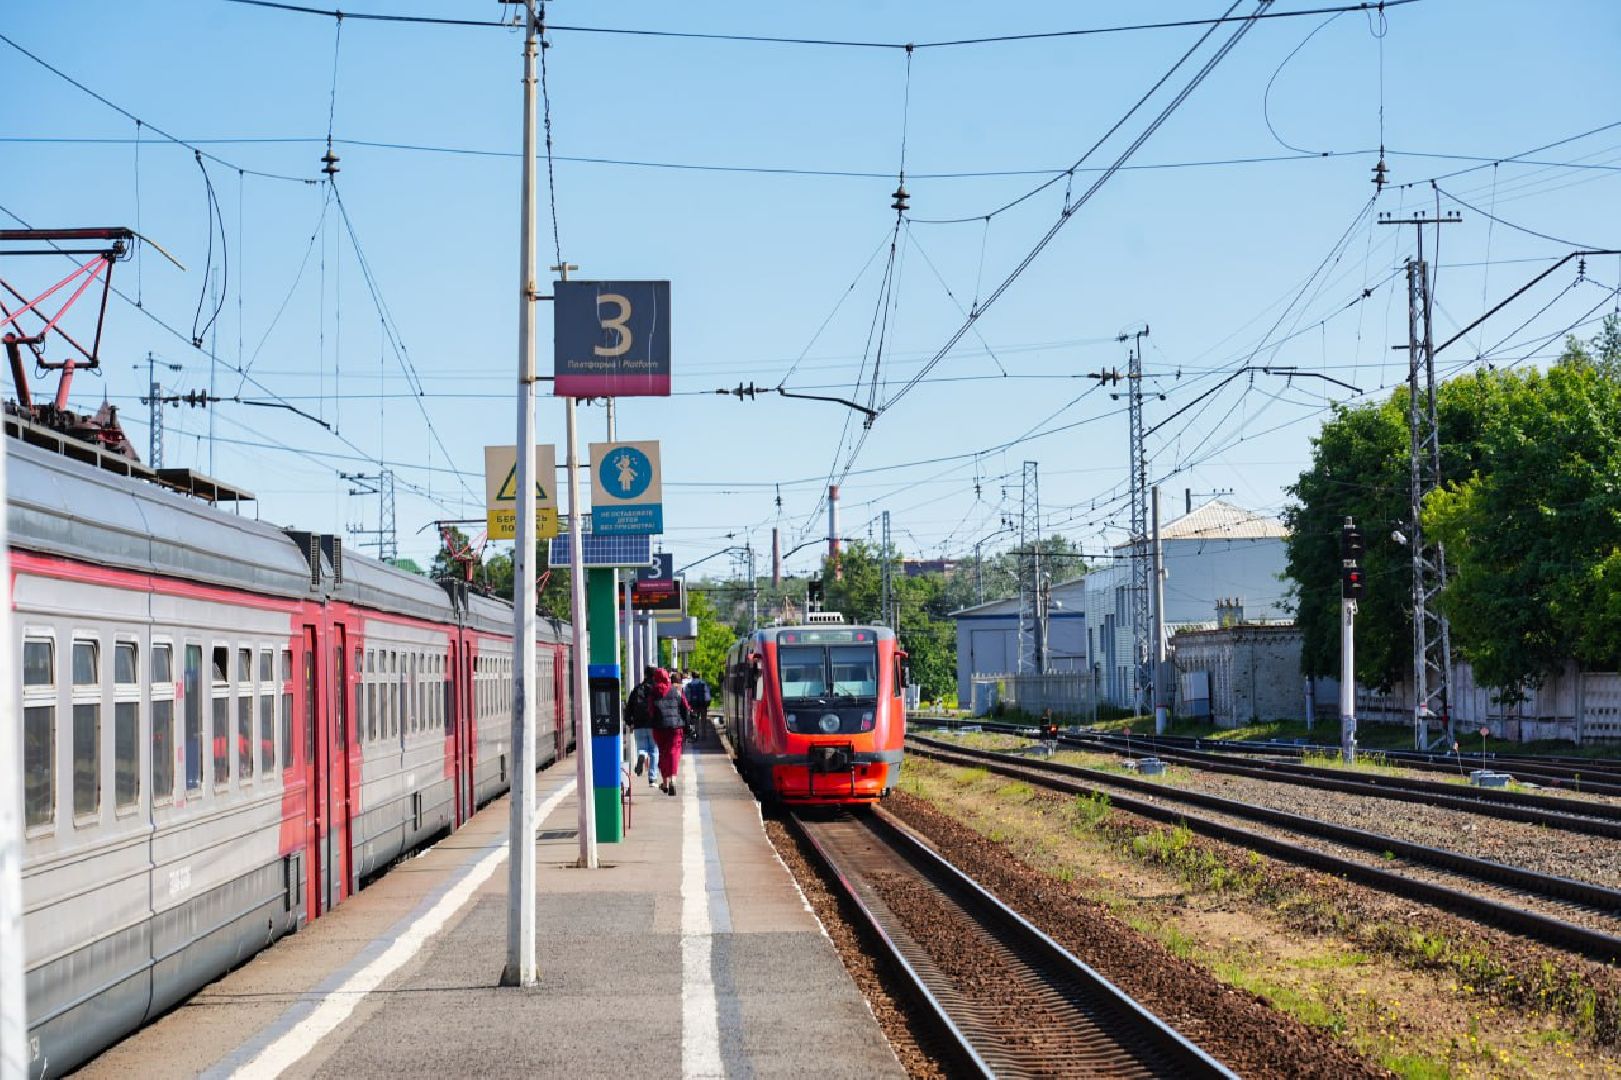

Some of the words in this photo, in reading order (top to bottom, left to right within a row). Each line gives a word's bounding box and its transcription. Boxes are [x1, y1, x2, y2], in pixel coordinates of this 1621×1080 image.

[594, 294, 632, 356] 3
[567, 359, 616, 369] Платформа
[623, 359, 659, 369] Platform
[496, 515, 548, 523] БЕРСЬ
[647, 557, 662, 579] 3
